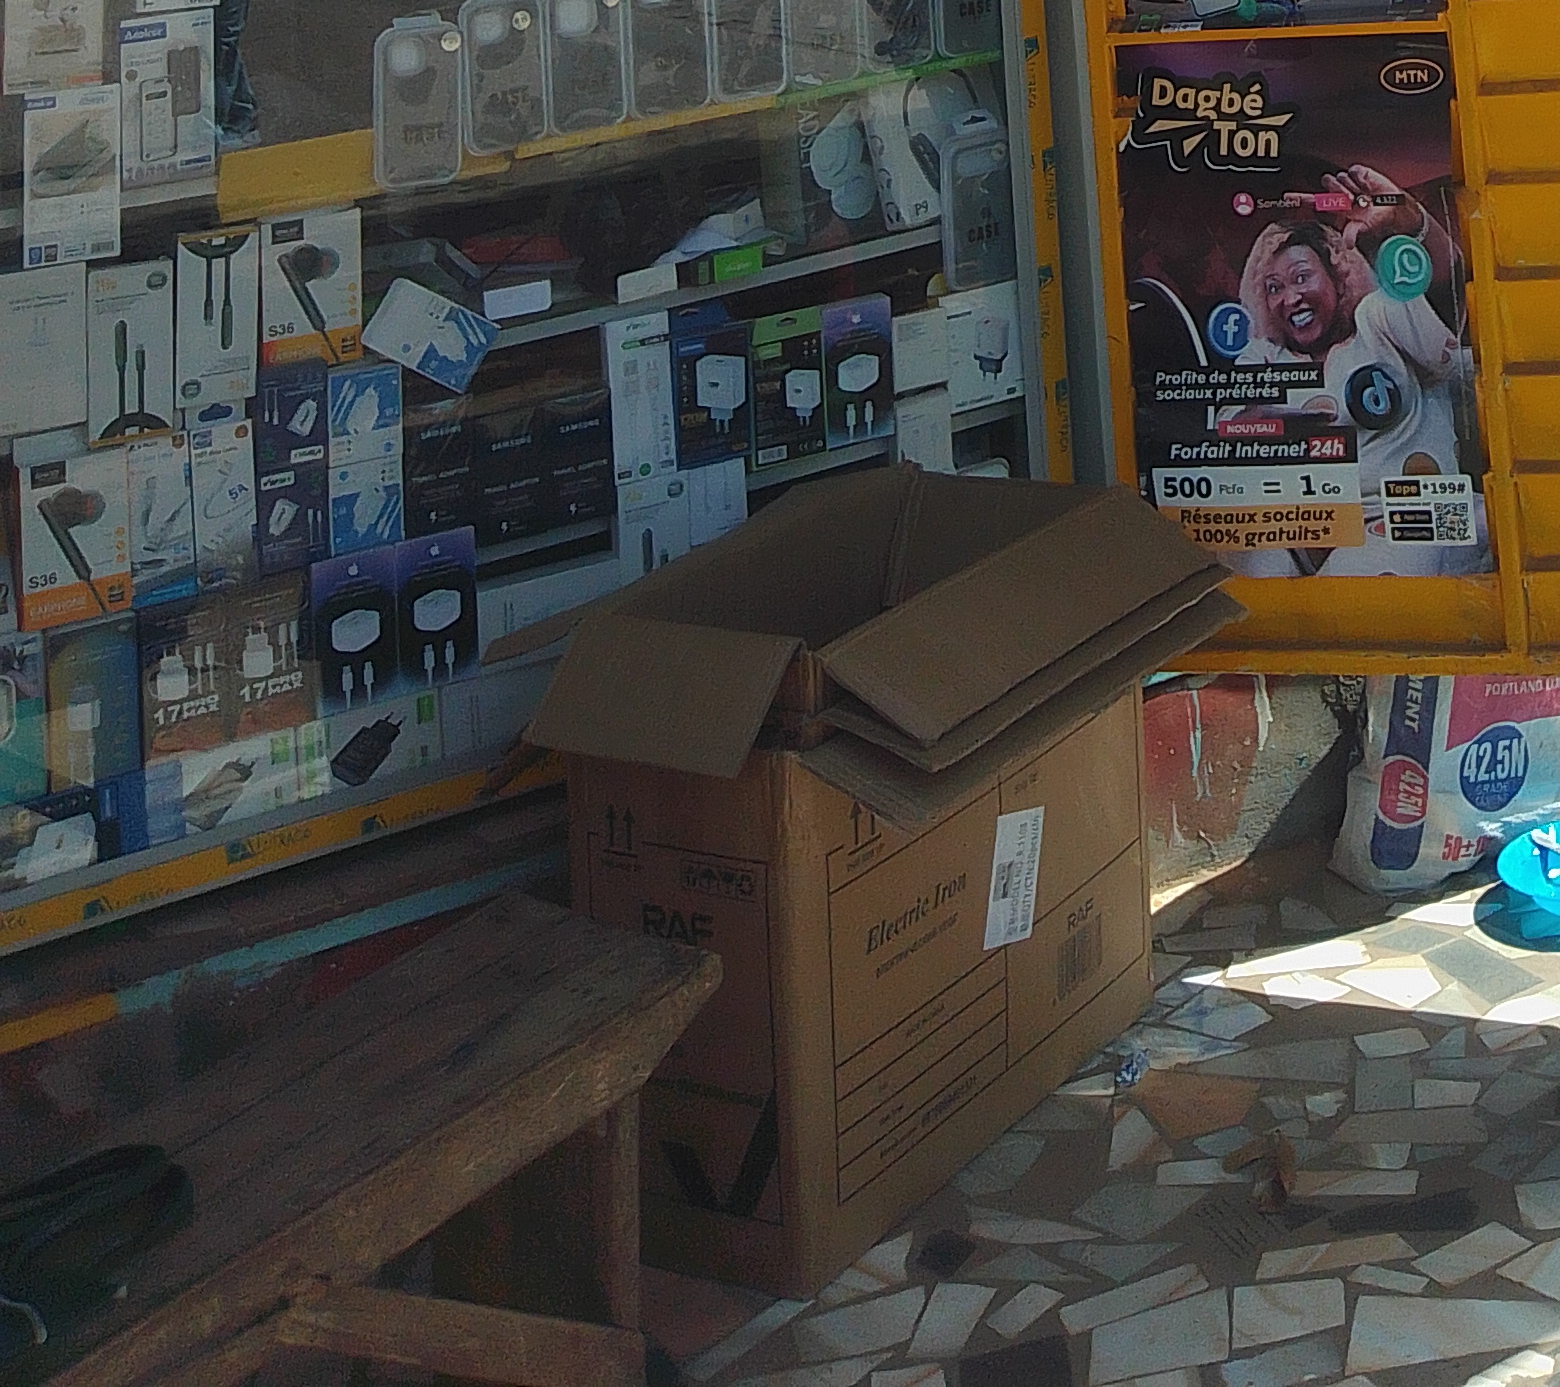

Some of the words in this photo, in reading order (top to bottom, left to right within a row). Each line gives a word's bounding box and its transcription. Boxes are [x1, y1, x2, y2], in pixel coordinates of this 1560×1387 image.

[1395, 70, 1429, 84] MTN
[1151, 77, 1264, 120] Dagbé
[1212, 121, 1280, 159] Ton
[1322, 196, 1346, 208] LIVE
[268, 322, 295, 338] S36
[1155, 370, 1206, 386] Profite
[1209, 369, 1227, 384] de
[1230, 369, 1253, 384] tes
[1256, 366, 1318, 383] réseaux
[1155, 385, 1214, 401] sociaux
[1216, 383, 1280, 402] préférés
[1226, 423, 1276, 435] NOUVEAU
[1170, 442, 1233, 461] Forfait
[1235, 441, 1307, 459] Internet
[1309, 438, 1344, 458] 24h
[1163, 476, 1212, 499] 500
[1299, 475, 1317, 497] 1
[1321, 482, 1341, 496] Go
[1387, 482, 1419, 497] Tape
[1180, 507, 1257, 524] Réseaux
[1262, 507, 1335, 523] sociaux
[1192, 527, 1241, 544] 100%
[27, 571, 59, 590] S36
[1484, 678, 1544, 698] PORTLAND
[1462, 737, 1526, 785] 42.5N
[866, 896, 930, 956] Electric
[932, 872, 967, 911] Iron
[1066, 897, 1095, 933] RAF
